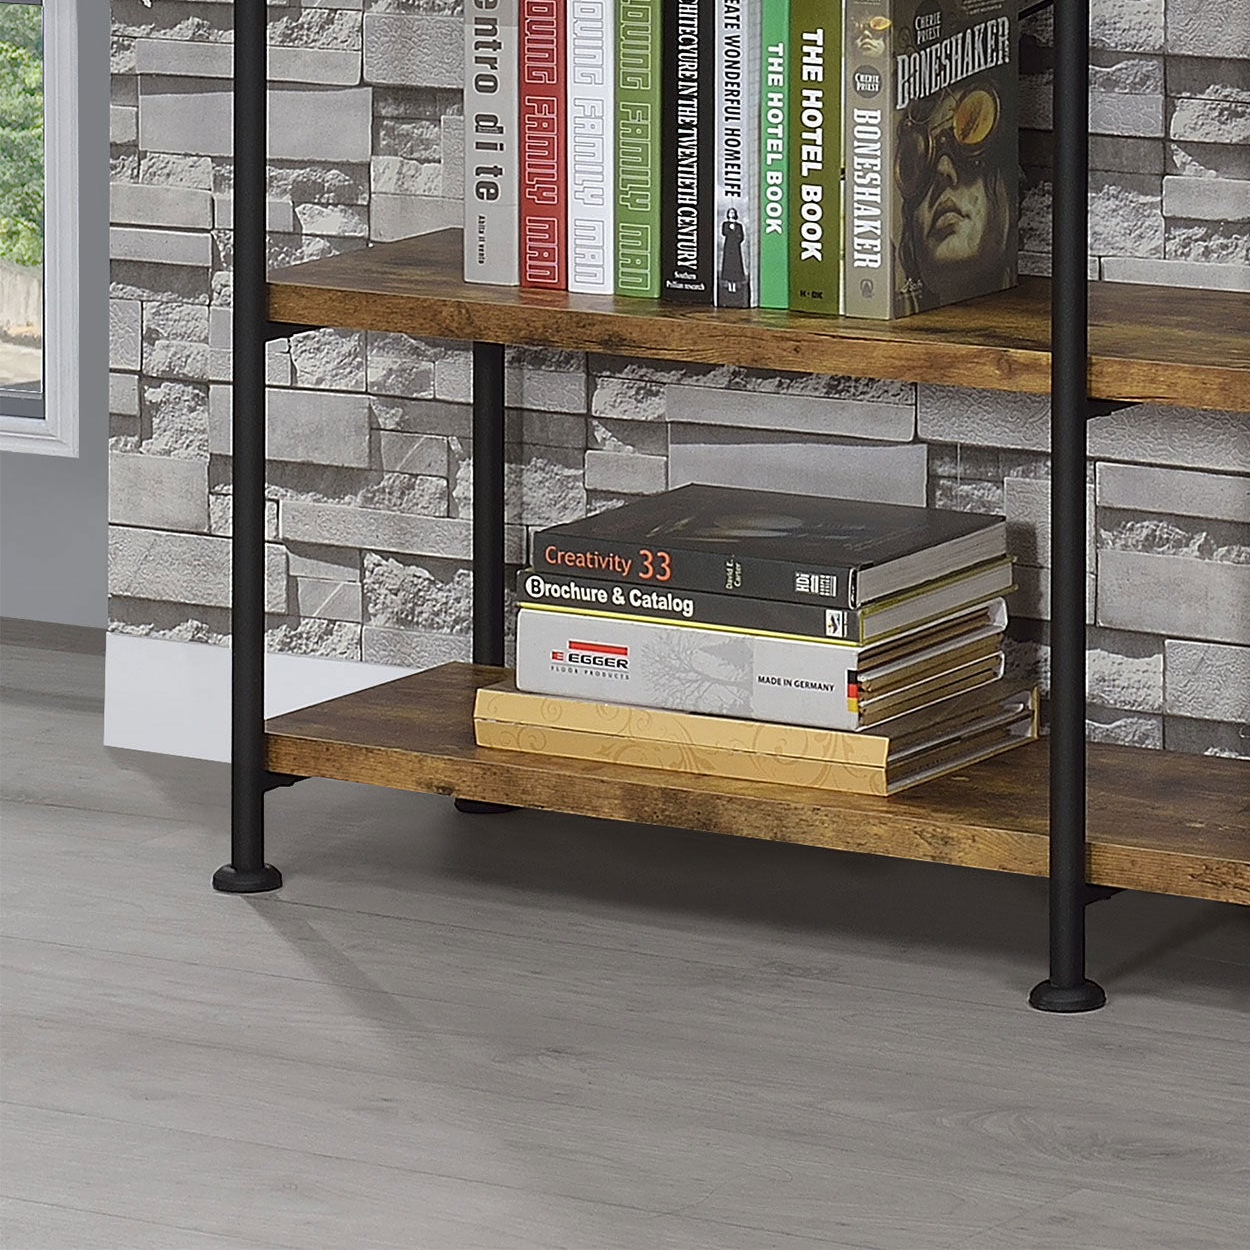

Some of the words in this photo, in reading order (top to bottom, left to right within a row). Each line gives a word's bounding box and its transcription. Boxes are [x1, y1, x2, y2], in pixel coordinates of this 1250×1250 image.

[915, 11, 941, 30] CHERIE
[917, 25, 941, 45] PRIEST
[724, 34, 741, 122] WONDERFUL
[767, 43, 784, 87] THE
[801, 28, 824, 83] THE
[896, 16, 1010, 111] BONESHAKER
[677, 98, 698, 125] THE
[678, 81, 698, 97] IN
[474, 112, 505, 151] di
[525, 96, 558, 204] FAMILY
[573, 97, 605, 206] FAMILY
[619, 101, 651, 212] FAMILY
[766, 92, 784, 166] HOTEL
[801, 89, 824, 177] HOTEL
[474, 164, 505, 202] te
[677, 127, 698, 205] TWENTIETH
[724, 128, 741, 198] HOMELIFE
[853, 108, 882, 269] BONESHAKER
[765, 171, 784, 235] BOOK
[800, 183, 824, 262] BOOK
[677, 207, 698, 270] CENTURY
[545, 545, 632, 577] Creativity
[638, 549, 673, 582] 33
[525, 575, 608, 604] Brochure
[612, 586, 626, 605] &
[629, 588, 694, 617] Catalog
[550, 665, 579, 674] FLOOR
[584, 669, 630, 680] PRODUCTS
[568, 653, 629, 669] EGGER
[758, 675, 782, 686] MADE
[783, 678, 792, 687] IN
[794, 680, 835, 691] GERMANY
